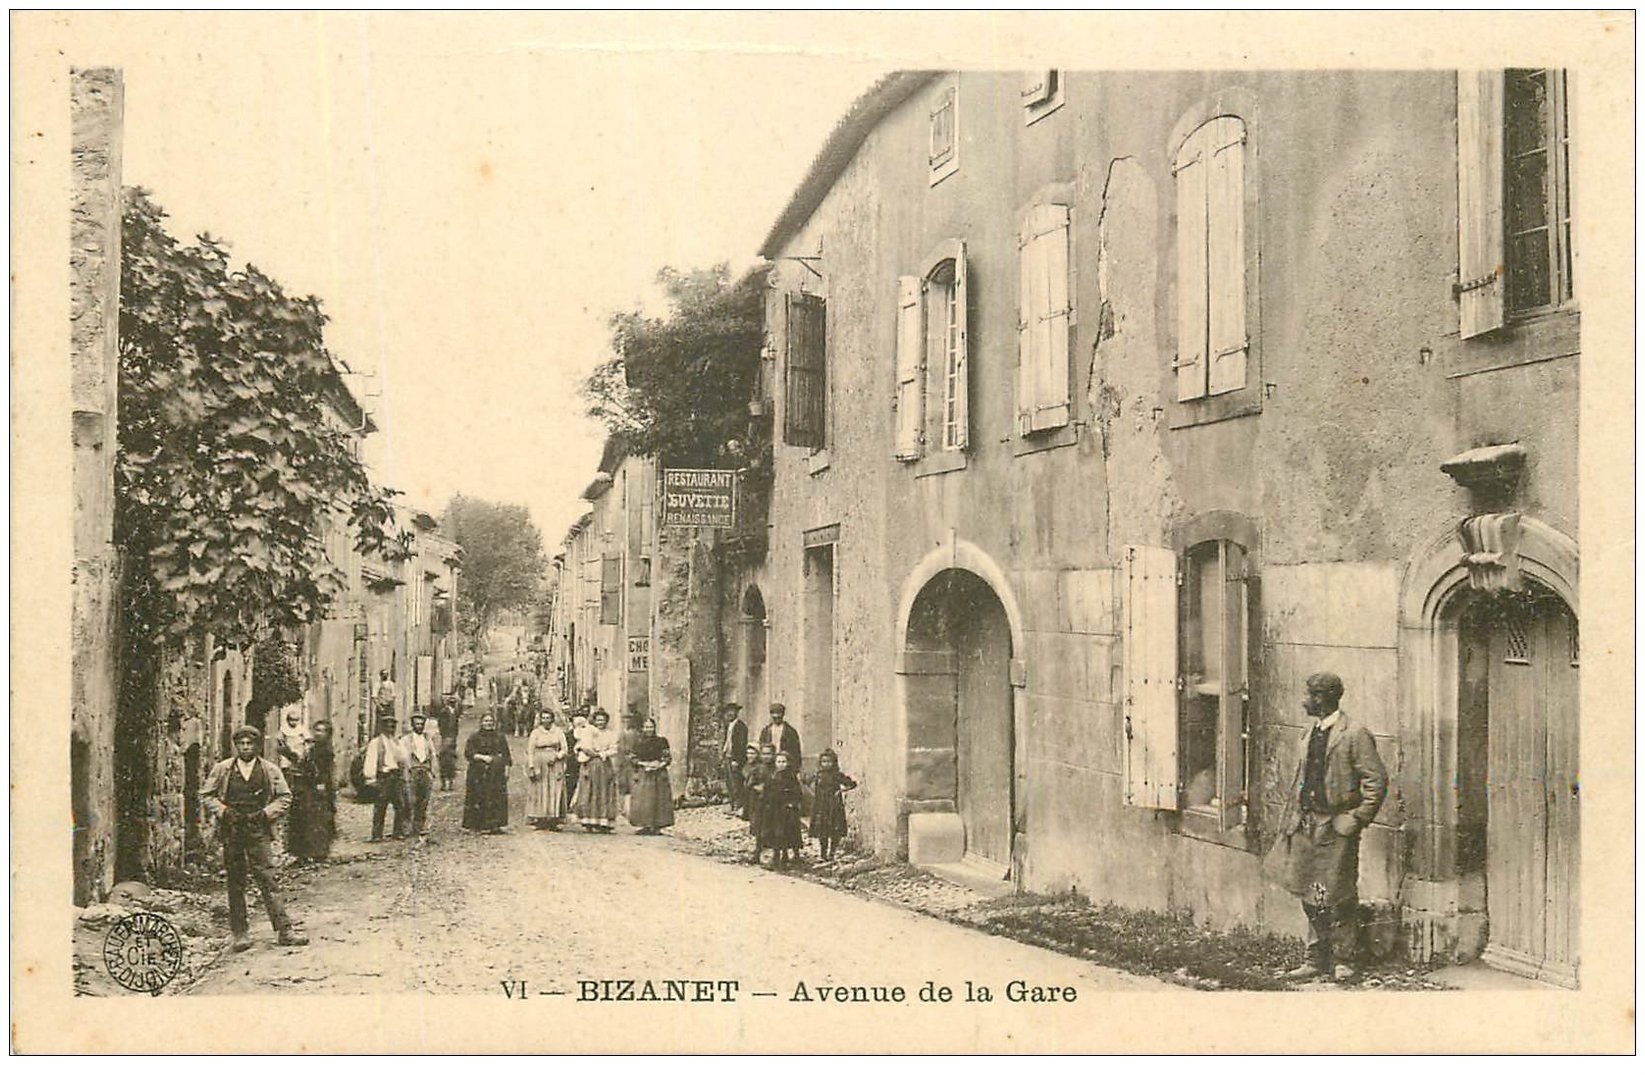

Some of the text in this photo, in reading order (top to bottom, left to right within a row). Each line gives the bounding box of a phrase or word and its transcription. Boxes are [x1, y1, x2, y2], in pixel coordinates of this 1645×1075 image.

[667, 472, 732, 487] RESTAURANT
[667, 493, 730, 509] BUVETTE
[667, 511, 731, 525] RENAISSANCE
